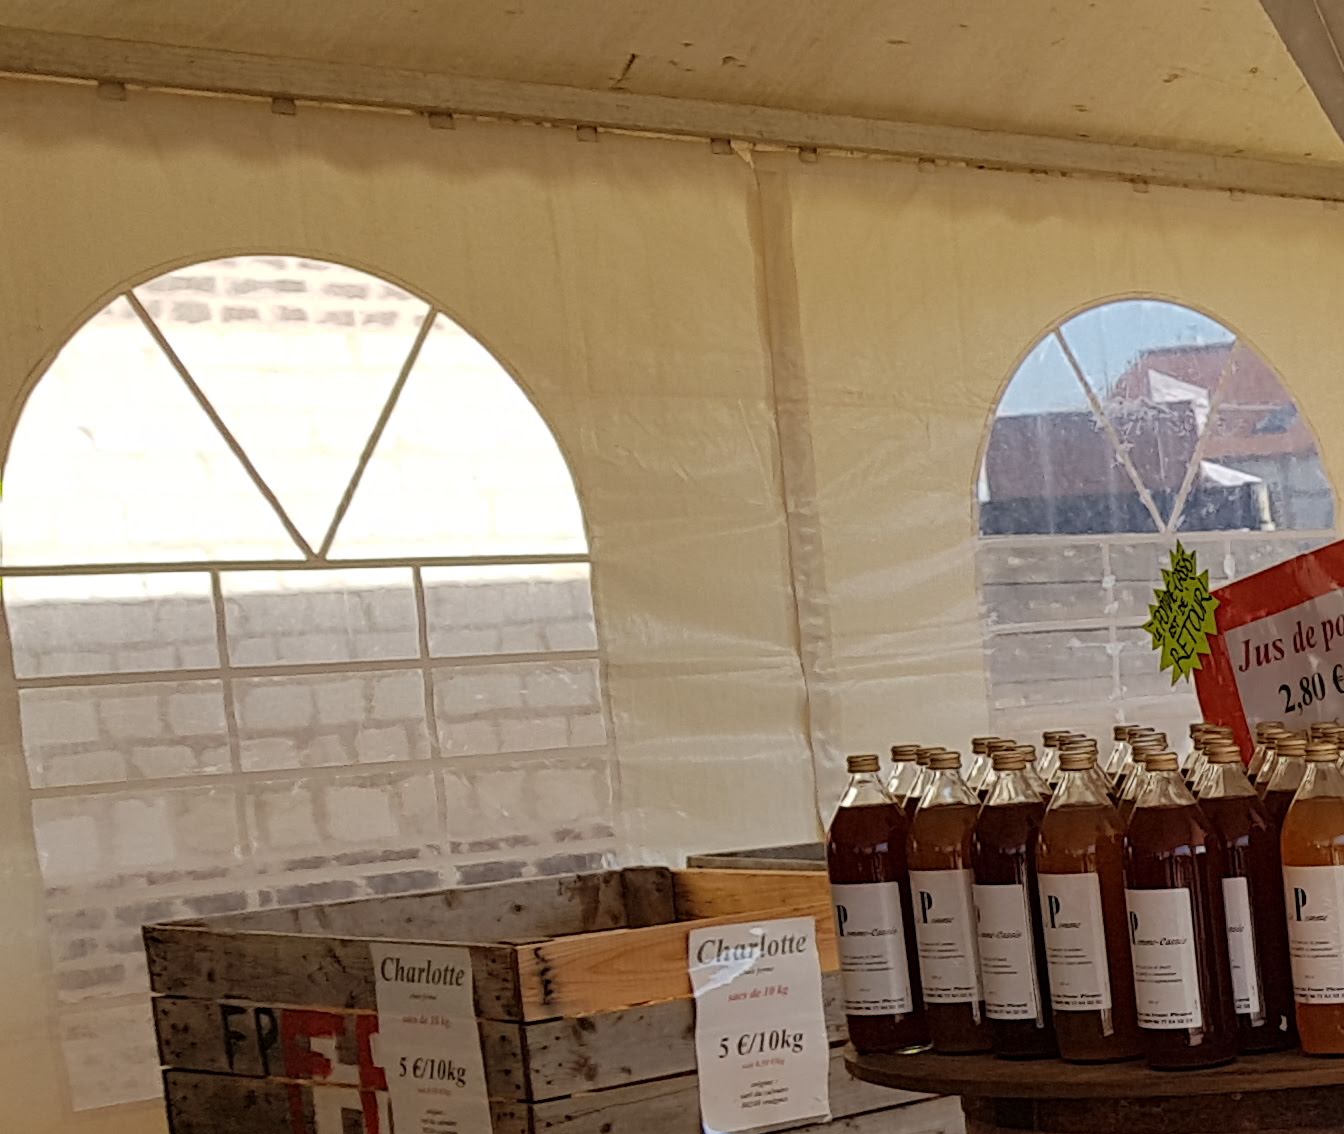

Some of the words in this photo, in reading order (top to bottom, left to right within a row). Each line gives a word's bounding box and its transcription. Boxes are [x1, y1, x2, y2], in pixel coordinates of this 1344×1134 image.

[1238, 637, 1286, 673] Jus
[1292, 620, 1318, 655] de
[1278, 672, 1327, 716] 2,80
[696, 932, 808, 965] Charlotte
[380, 956, 465, 987] Charlotte
[727, 990, 748, 1003] sacs
[749, 988, 763, 1000] de
[763, 986, 775, 998] 10
[775, 984, 790, 998] kg
[718, 1036, 730, 1059] 5
[737, 1027, 804, 1056] €/10kg
[398, 1056, 408, 1078] 5
[412, 1056, 467, 1089] €/10kg
